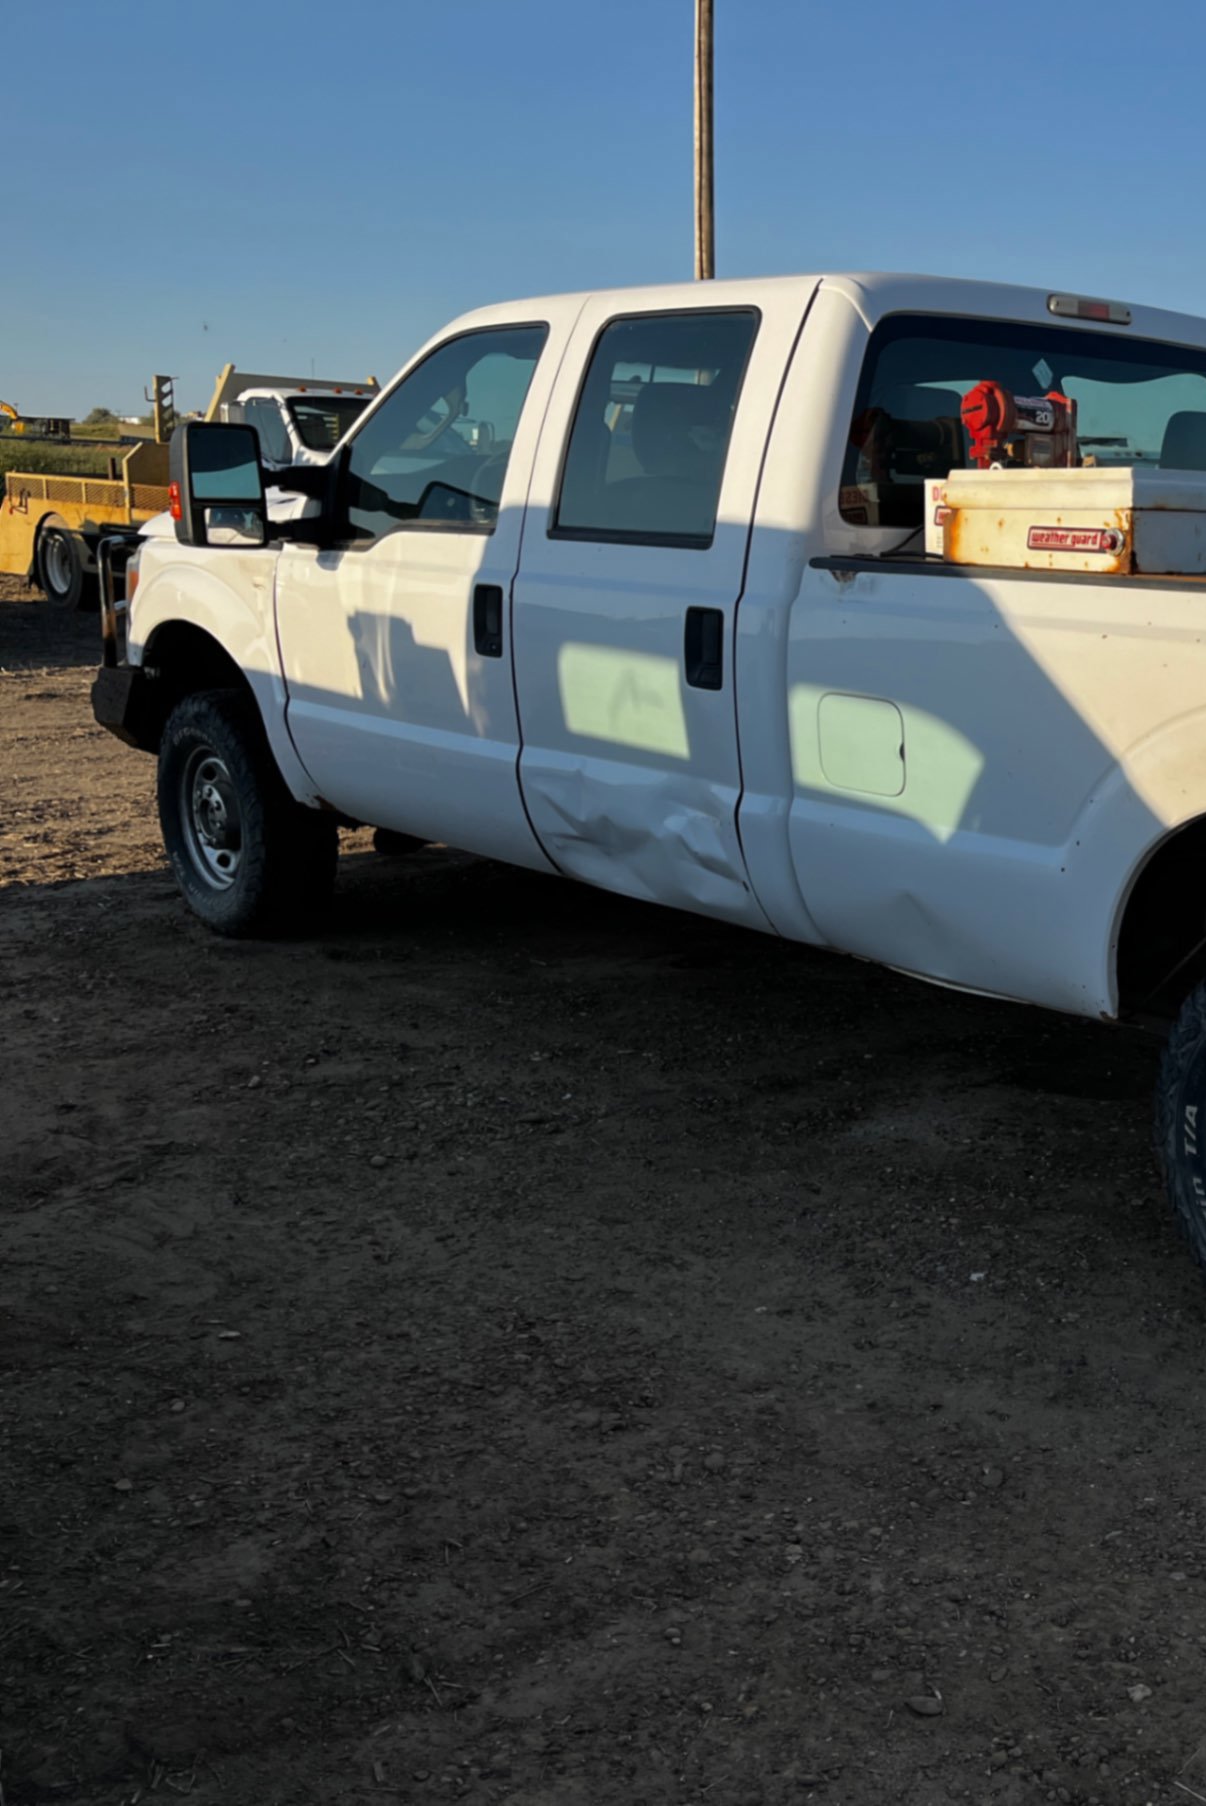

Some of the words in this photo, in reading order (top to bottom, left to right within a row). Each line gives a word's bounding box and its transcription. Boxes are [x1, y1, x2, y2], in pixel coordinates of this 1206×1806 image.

[1036, 411, 1050, 423] 20
[1031, 532, 1069, 544] weather
[1071, 533, 1098, 546] guard
[1183, 1104, 1200, 1156] T/A
